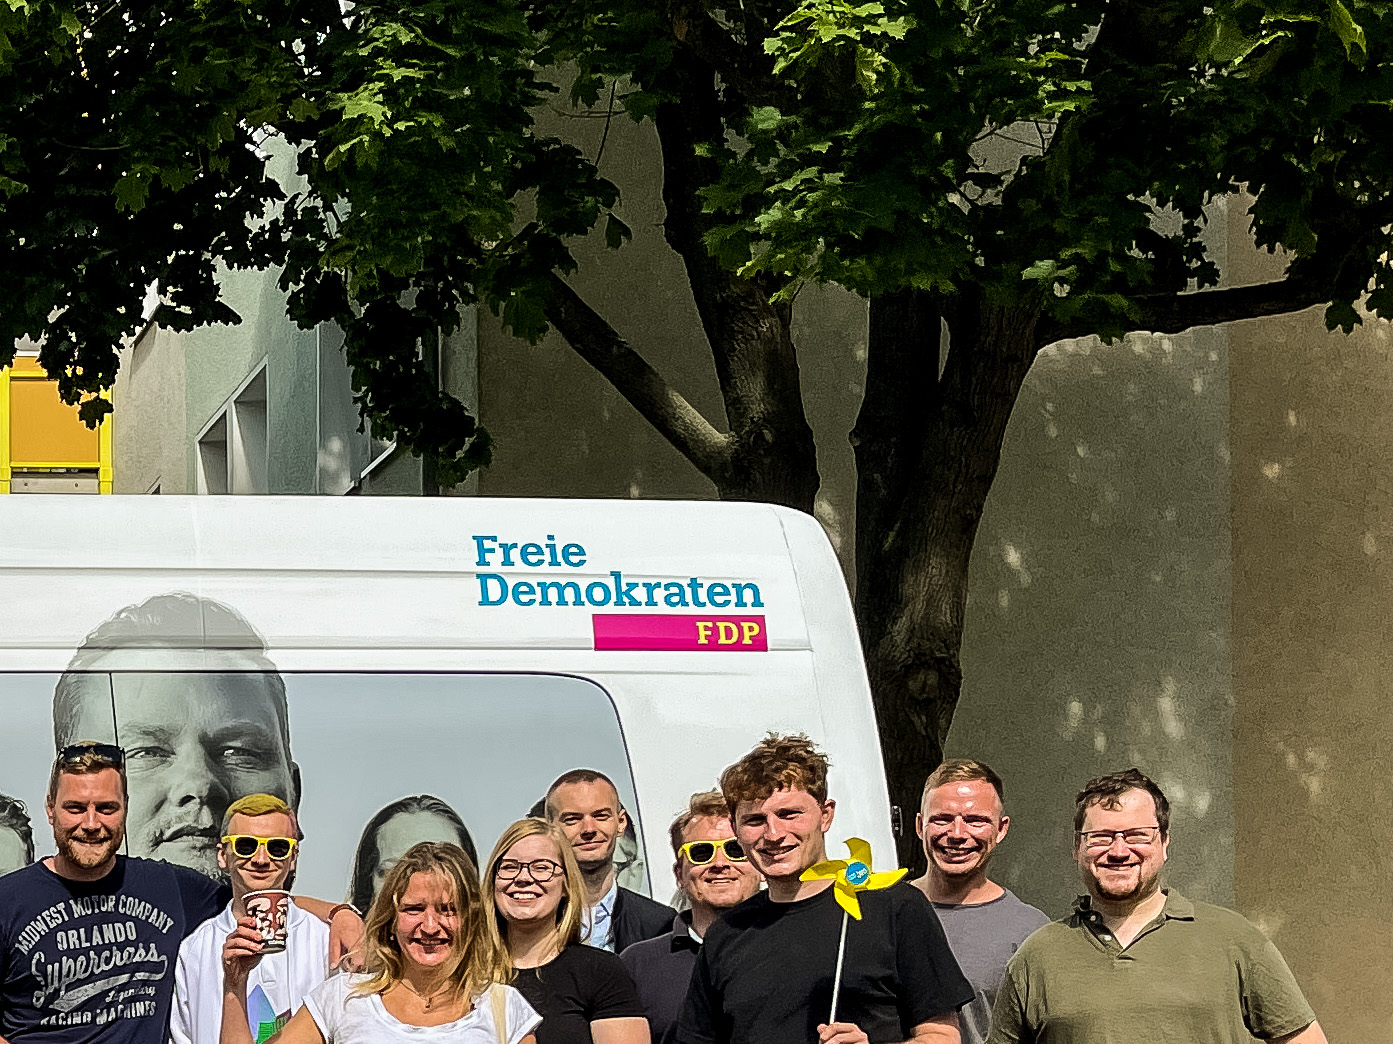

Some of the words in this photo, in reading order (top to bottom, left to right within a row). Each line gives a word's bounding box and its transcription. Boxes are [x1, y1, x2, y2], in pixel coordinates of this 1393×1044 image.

[472, 535, 587, 567] Freie
[476, 571, 764, 607] Demokraten
[696, 621, 760, 645] FDP
[15, 902, 70, 955] MIDWEST
[69, 895, 116, 919] MOTOR
[118, 894, 174, 934] COMPANY
[56, 921, 137, 951] ORLANDO
[31, 943, 164, 1008] Supercross
